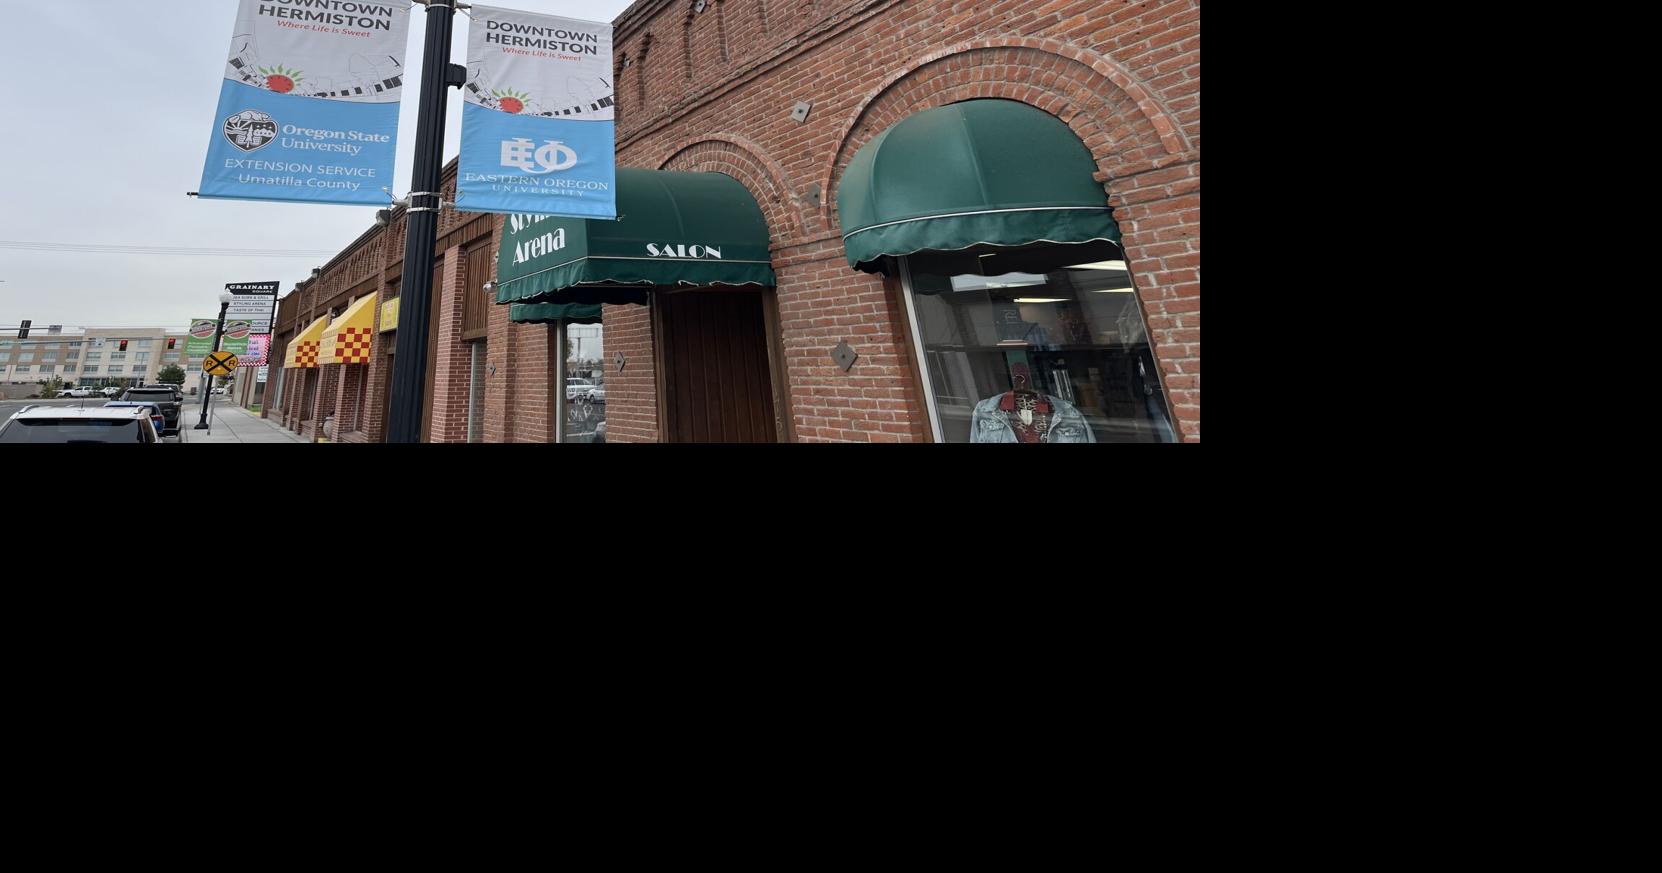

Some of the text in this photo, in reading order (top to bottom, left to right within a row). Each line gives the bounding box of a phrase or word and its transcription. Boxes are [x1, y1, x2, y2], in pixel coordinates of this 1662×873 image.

[258, 4, 391, 31] HERMISTON
[260, 0, 393, 18] OWNTOWN
[277, 20, 371, 38] Where Life is Sweet
[486, 20, 598, 43] DOWNTOWN
[486, 32, 597, 56] HERMISTON
[502, 47, 582, 62] Where Life is Sweet
[282, 124, 390, 143] Oregon State
[281, 137, 362, 156] University
[224, 158, 376, 178] EXTENSION SERVICE
[238, 173, 361, 192] Umatilla County
[464, 172, 608, 191] EASTERN OREGON
[491, 184, 584, 197] UNIVERSITY
[512, 228, 566, 267] Arena
[646, 242, 722, 259] SALON
